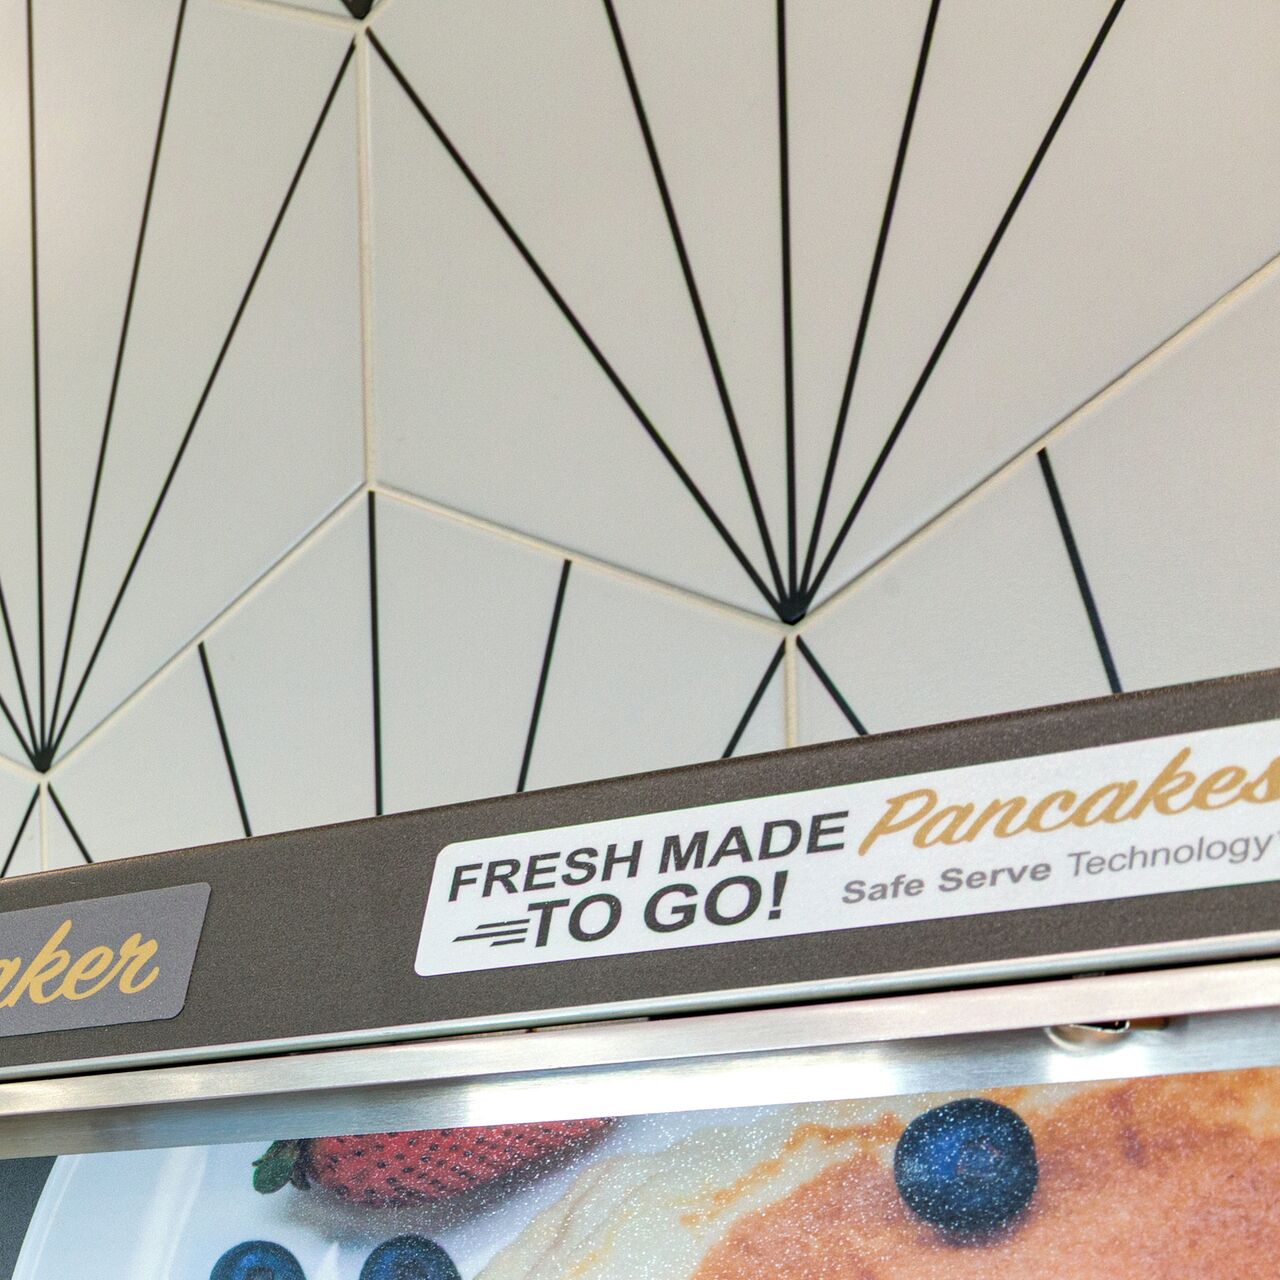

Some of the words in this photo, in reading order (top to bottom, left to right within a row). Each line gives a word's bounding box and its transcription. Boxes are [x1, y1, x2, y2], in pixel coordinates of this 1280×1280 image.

[448, 840, 643, 902] FRESH
[658, 810, 850, 874] MADE
[859, 747, 1280, 855] Pancakes
[841, 873, 925, 905] Safe
[938, 862, 1053, 893] Serve
[1067, 834, 1275, 877] Technology
[526, 893, 623, 948] TO
[644, 870, 788, 933] GO!
